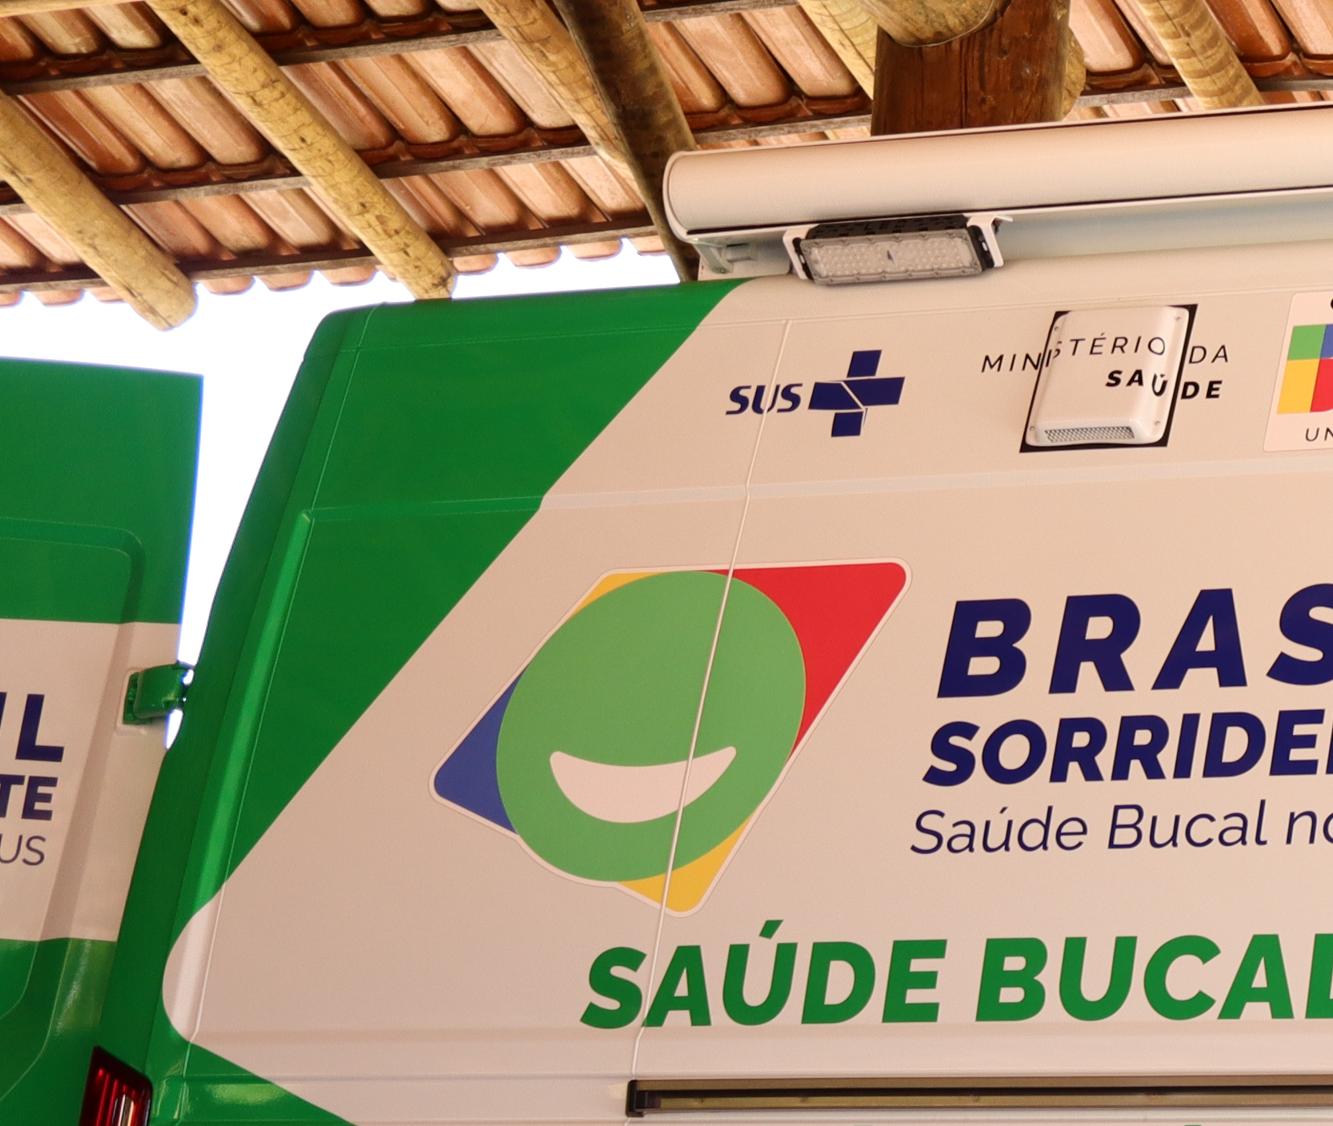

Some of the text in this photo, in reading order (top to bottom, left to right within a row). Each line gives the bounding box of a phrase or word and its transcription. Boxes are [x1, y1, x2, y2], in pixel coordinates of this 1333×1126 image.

[981, 332, 1229, 373] MINISTÉRIO DA
[725, 382, 803, 416] SUS
[1105, 369, 1223, 400] SAÚDE
[909, 805, 1089, 856] Saúde
[1106, 801, 1267, 849] Bucal
[579, 919, 948, 1030] SAÚDE
